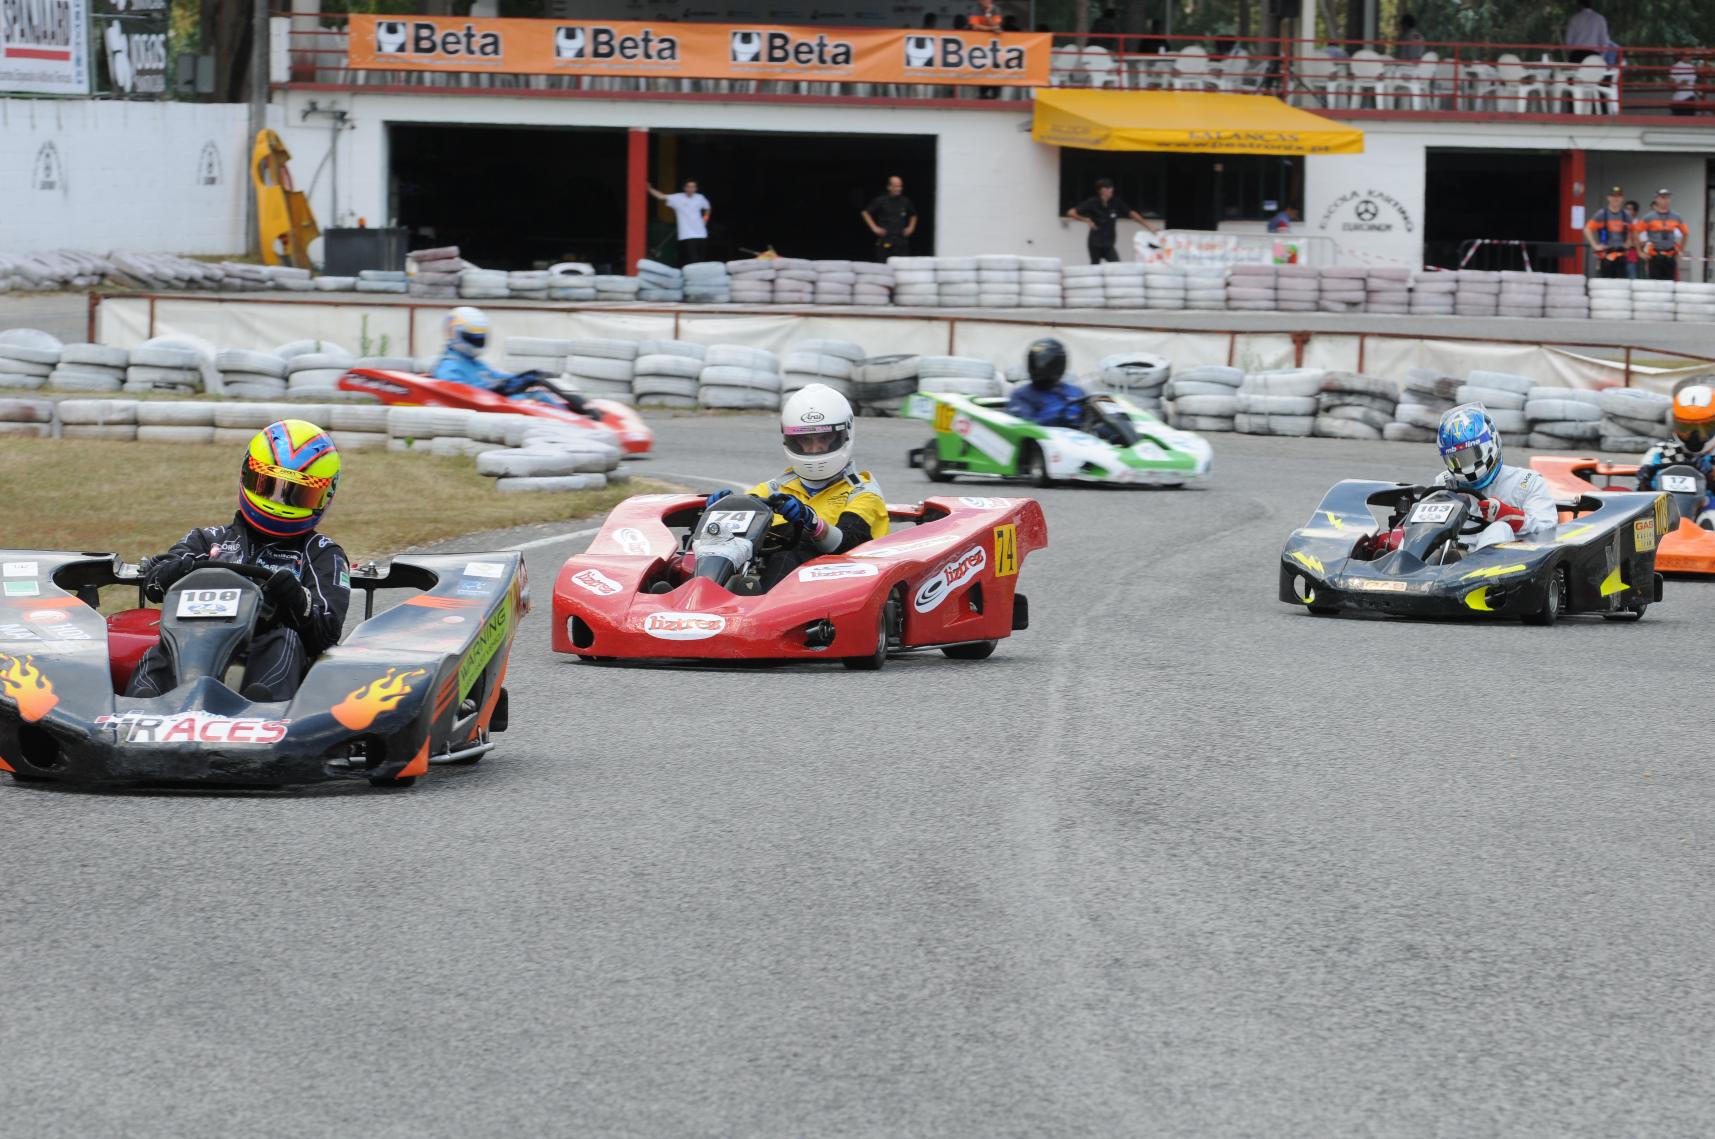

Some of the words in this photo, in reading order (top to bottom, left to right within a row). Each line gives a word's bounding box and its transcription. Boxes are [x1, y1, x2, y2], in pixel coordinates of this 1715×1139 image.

[413, 23, 501, 56] Beta
[592, 27, 677, 60] Beta
[767, 32, 851, 65] Beta
[941, 37, 1024, 70] Beta
[1671, 476, 1687, 484] 17
[714, 511, 748, 521] 74
[1635, 520, 1653, 531] GAS
[995, 527, 1015, 574] 74
[459, 606, 507, 681] WARNING
